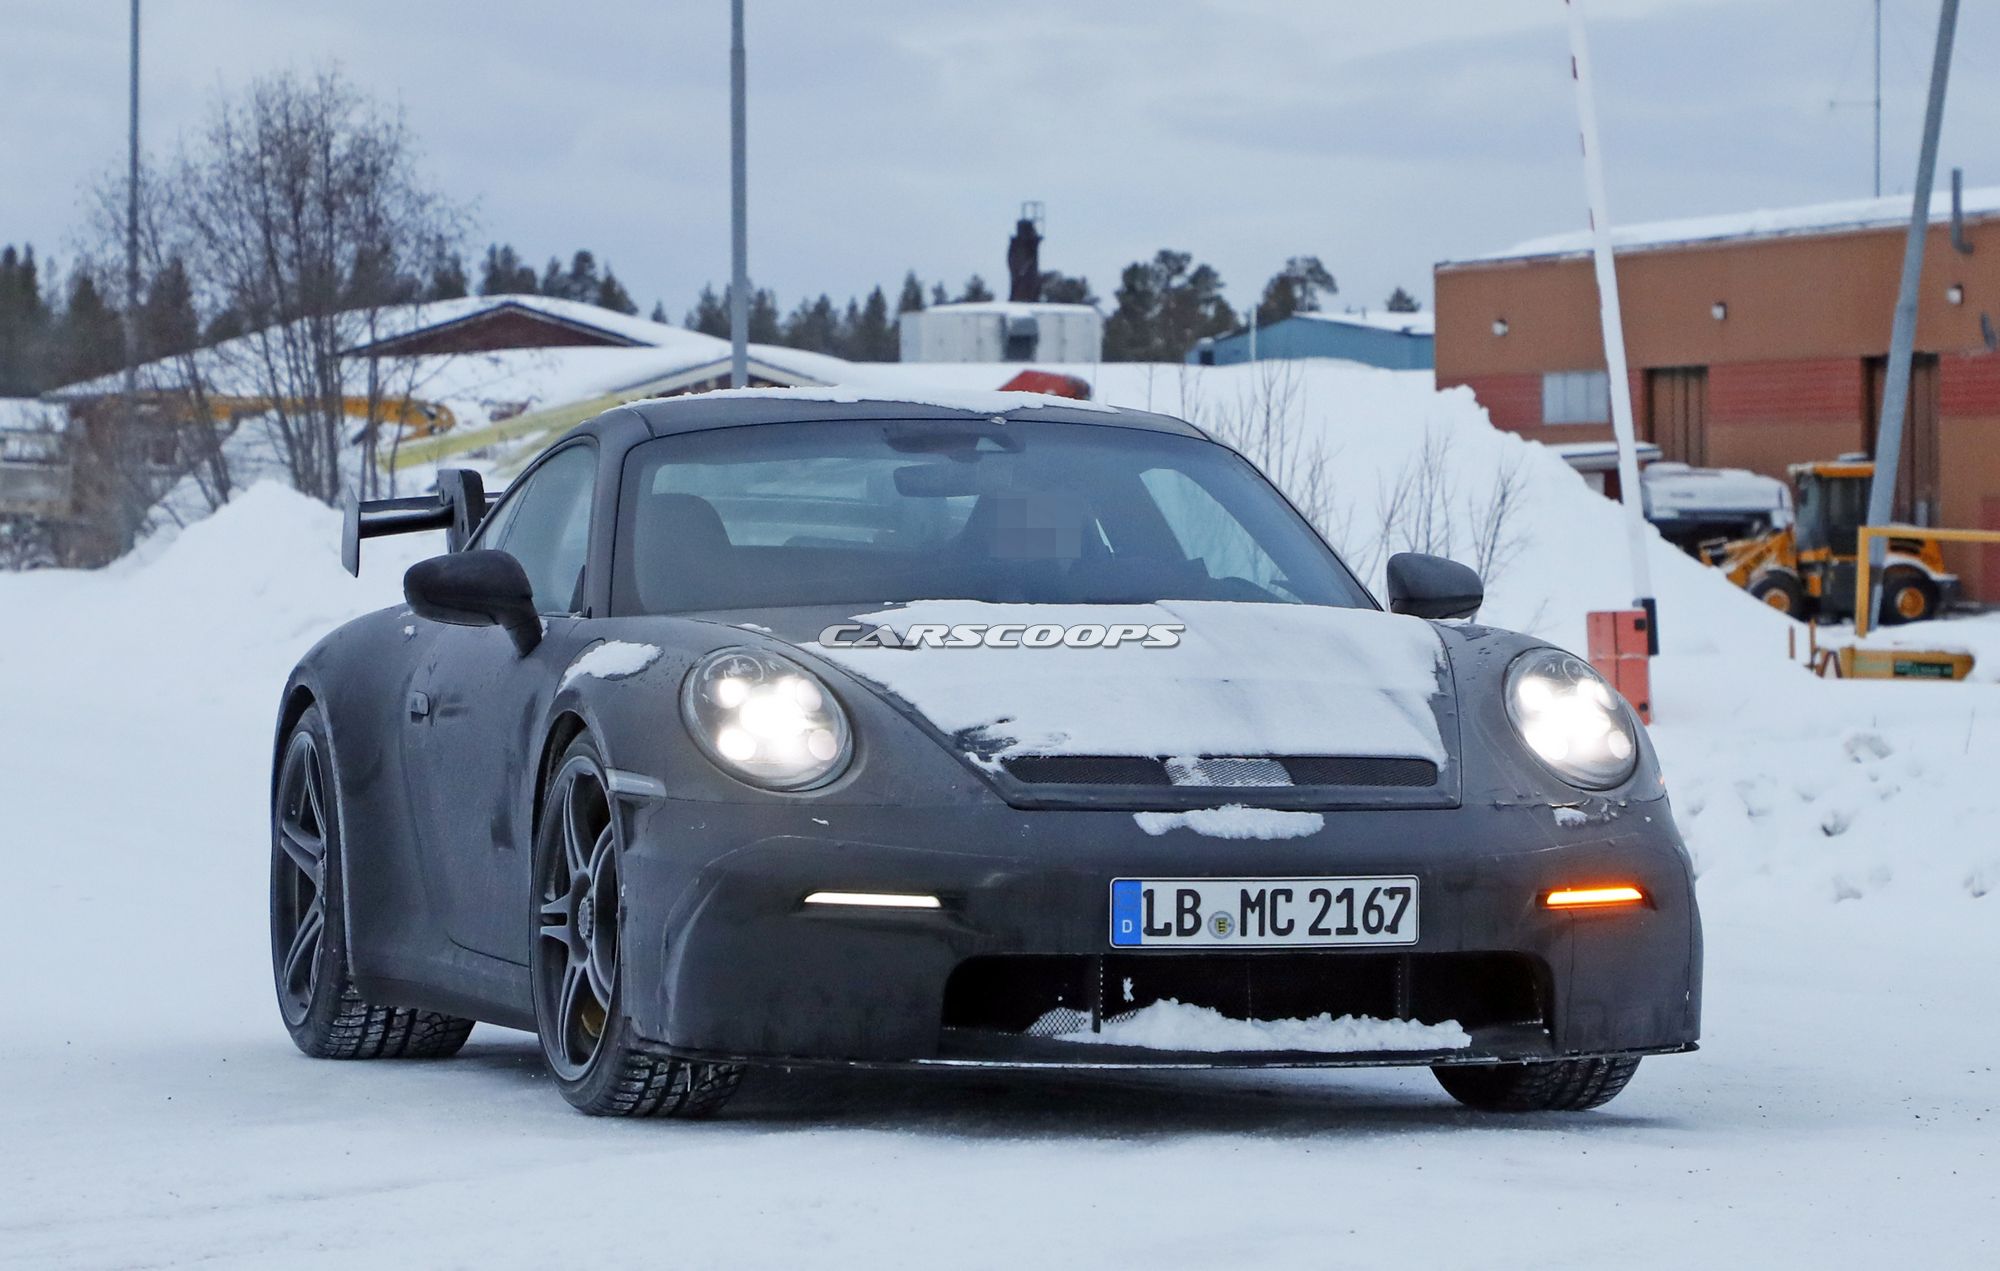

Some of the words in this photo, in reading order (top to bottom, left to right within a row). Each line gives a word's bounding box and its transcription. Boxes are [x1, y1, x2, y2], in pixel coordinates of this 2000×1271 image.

[1122, 920, 1133, 933] D
[1143, 889, 1202, 936] LB
[1240, 888, 1295, 936] MC
[1308, 887, 1411, 936] 2167
